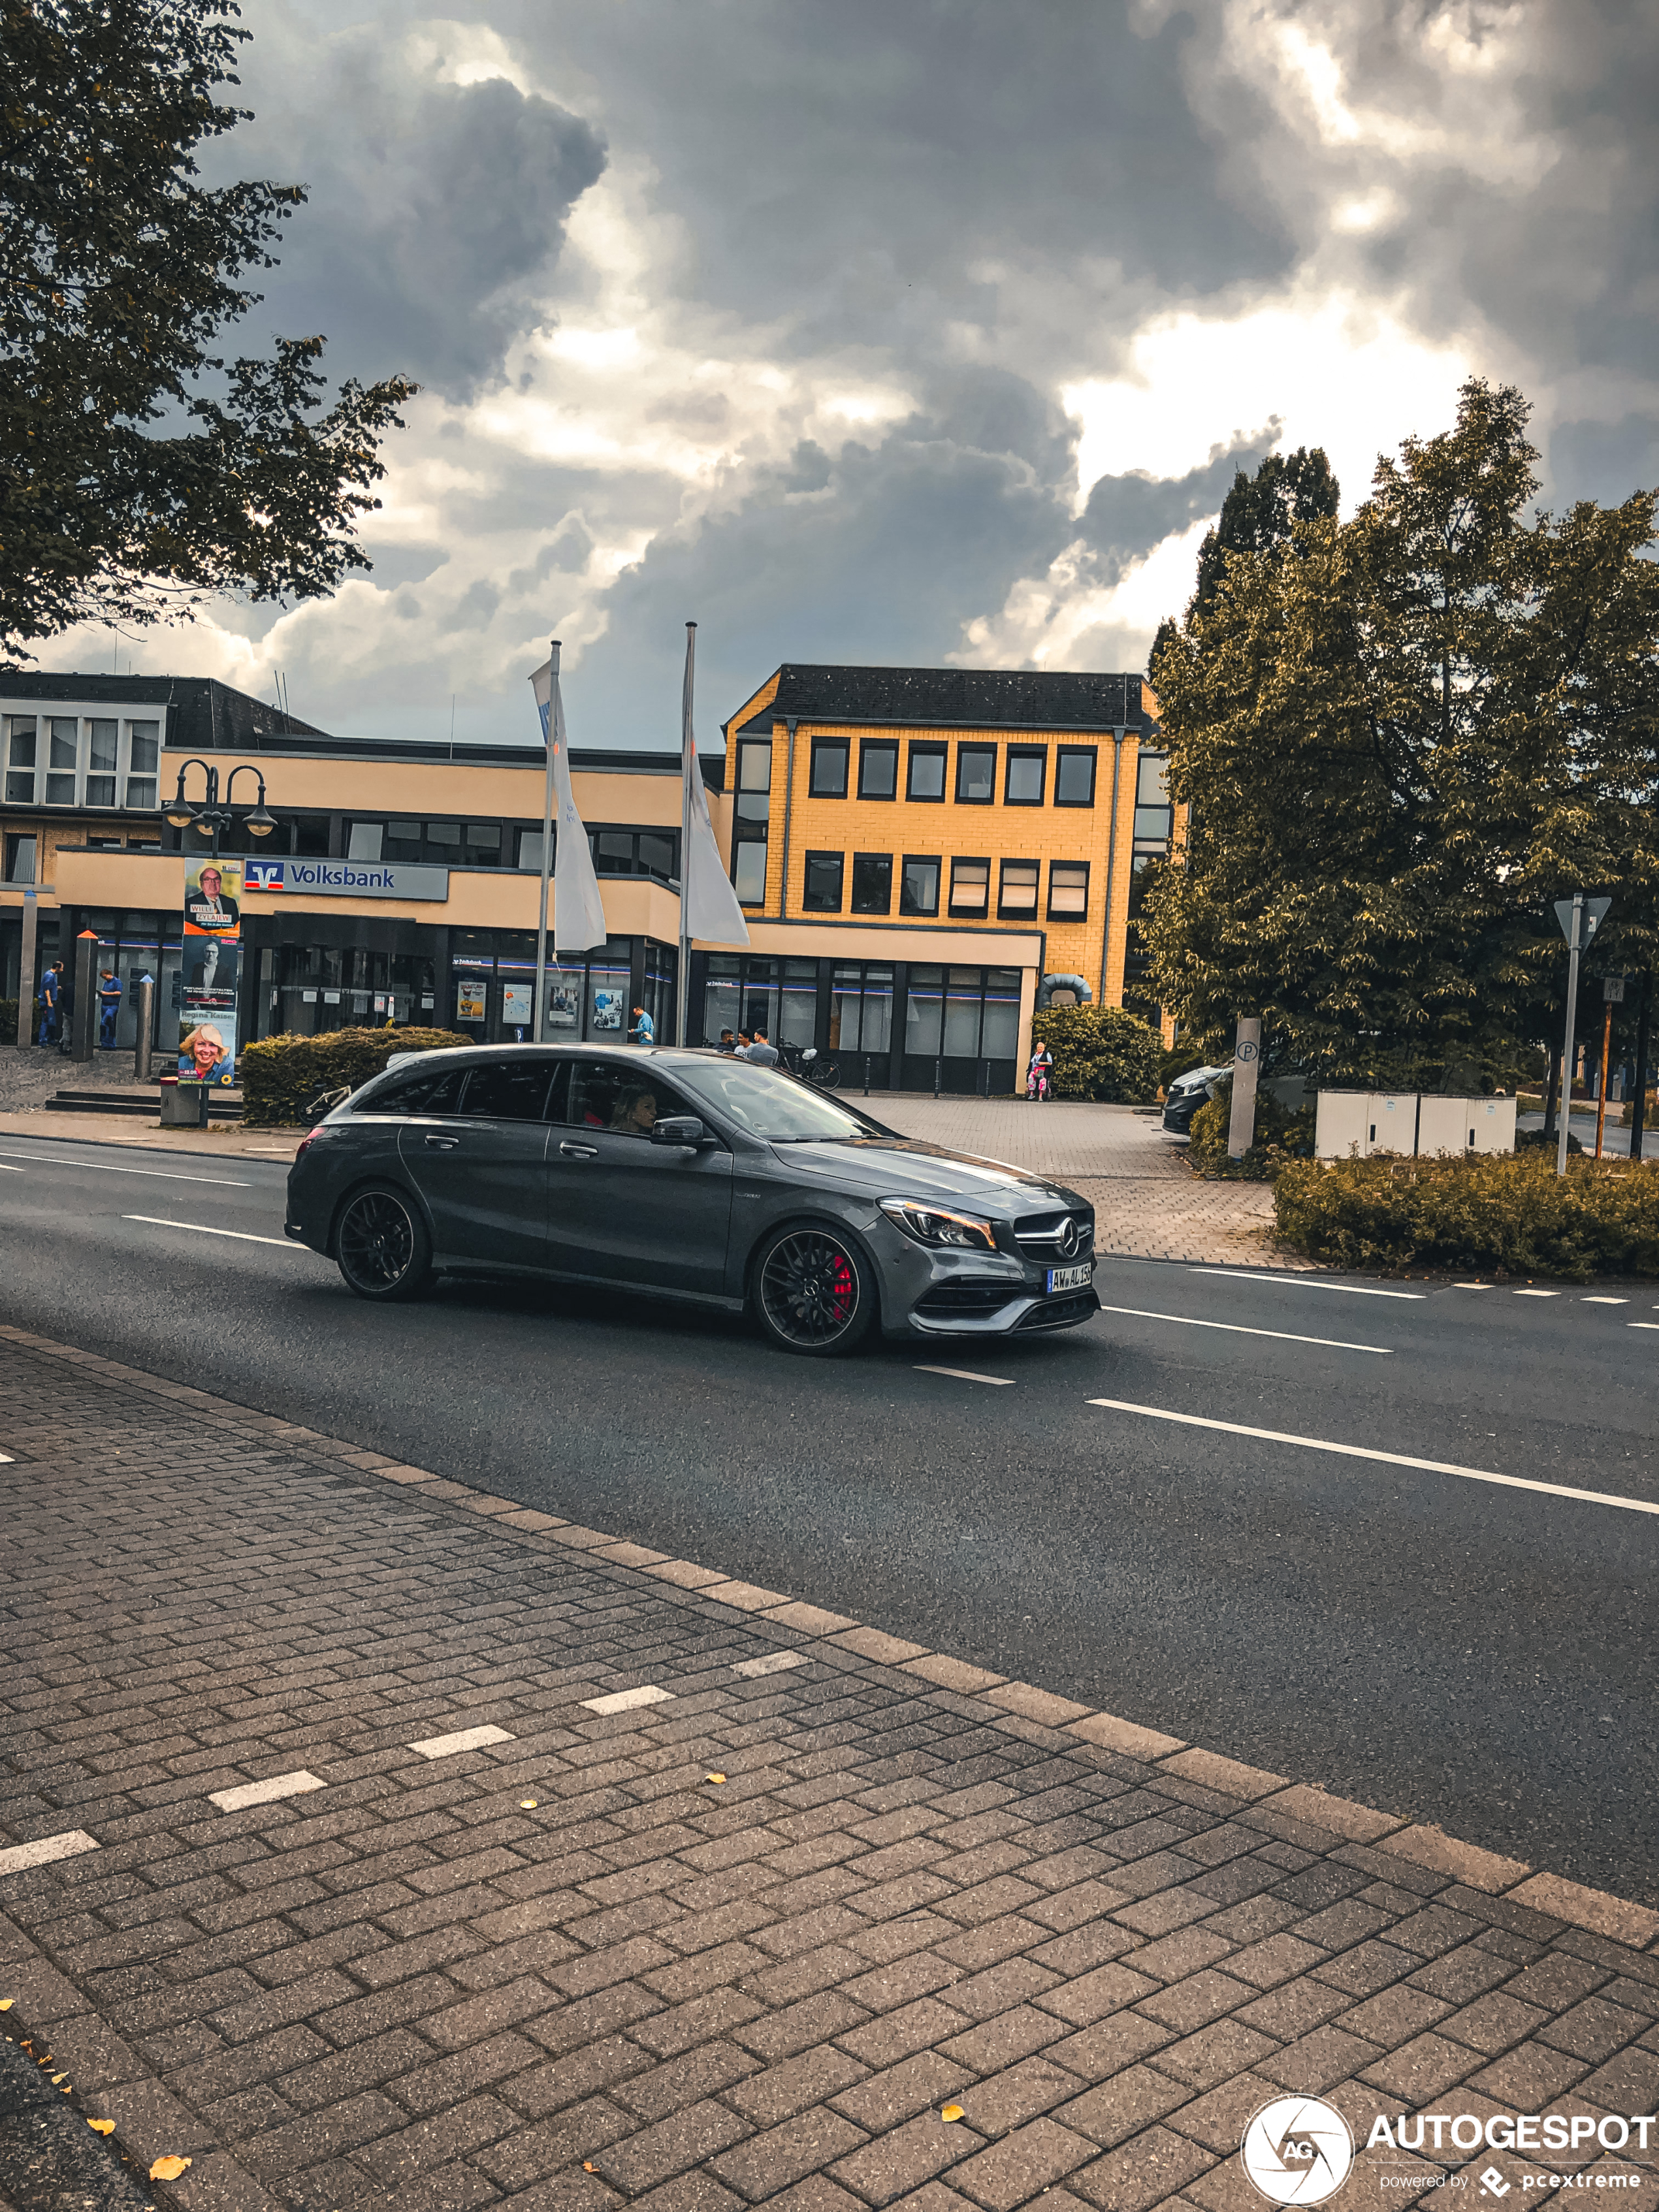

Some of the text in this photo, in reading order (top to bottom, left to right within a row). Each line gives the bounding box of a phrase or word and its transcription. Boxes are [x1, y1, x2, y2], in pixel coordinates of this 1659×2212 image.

[291, 865, 395, 888] Volksbank
[182, 1011, 208, 1019] Regina
[1244, 1045, 1252, 1059] P
[1053, 1265, 1090, 1289] AW AL 156
